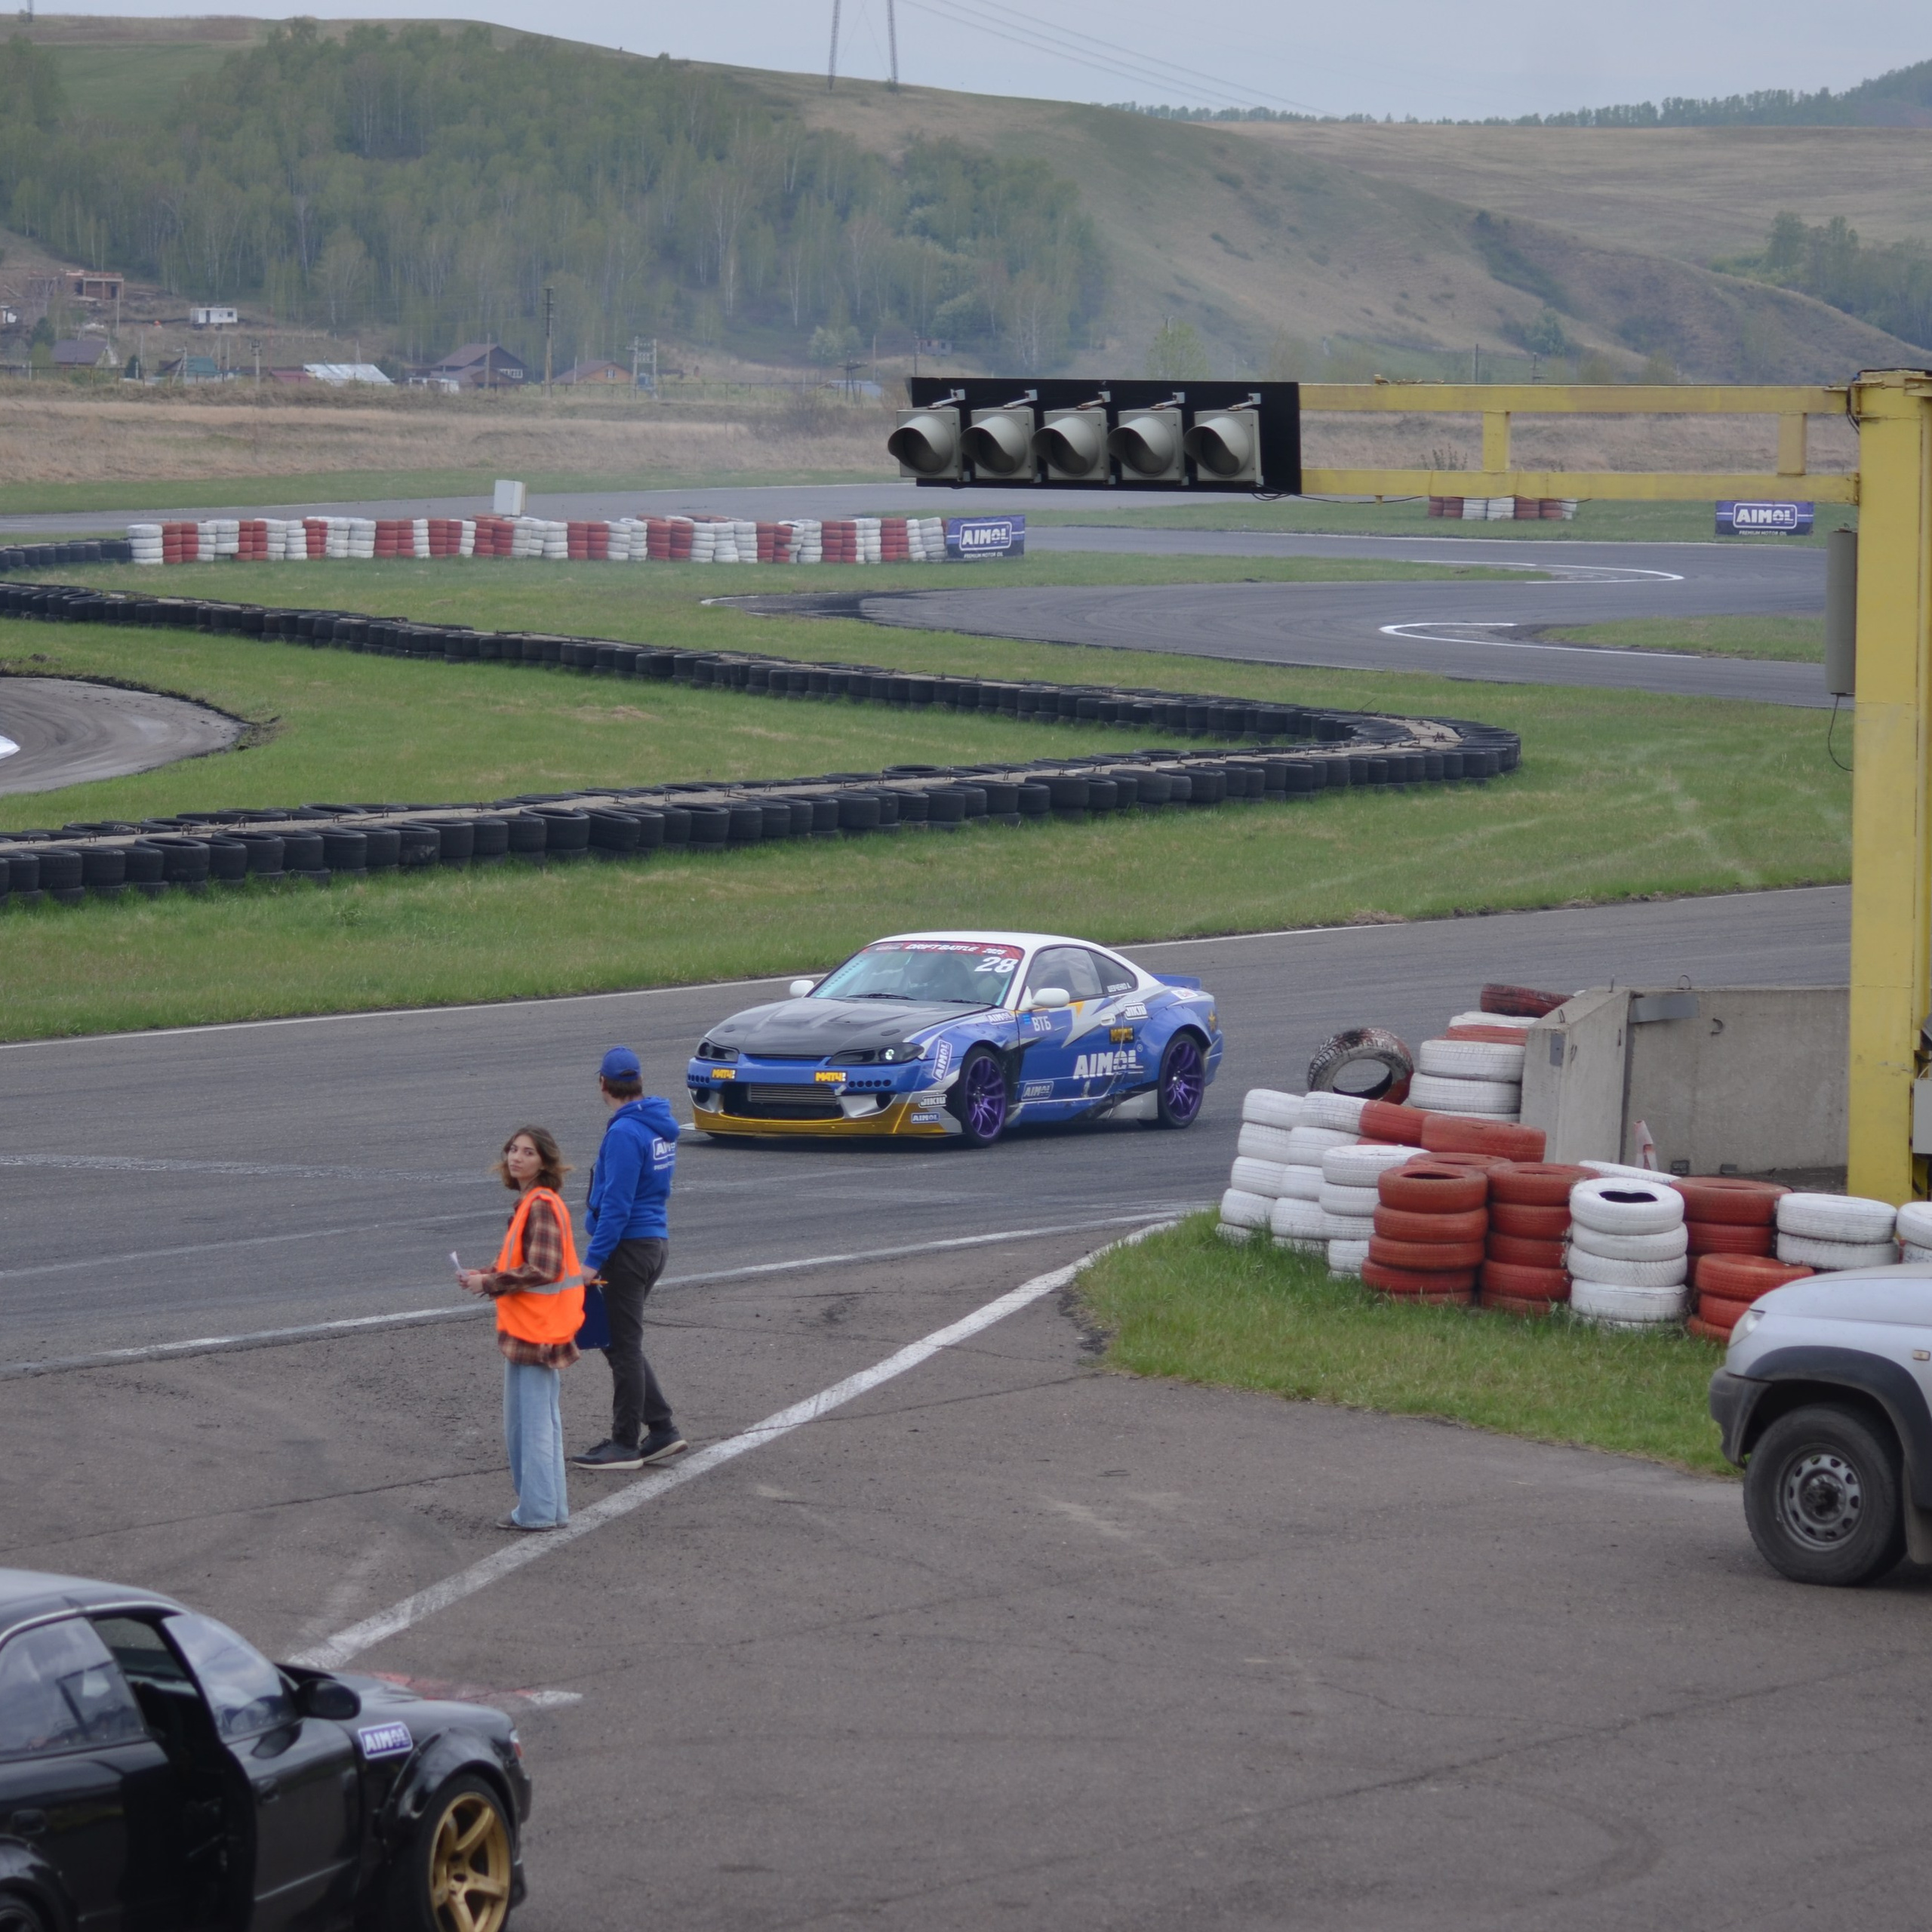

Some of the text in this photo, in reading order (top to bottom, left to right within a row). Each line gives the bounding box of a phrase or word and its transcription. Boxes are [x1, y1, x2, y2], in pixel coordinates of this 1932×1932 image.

[1737, 509, 1794, 524] AIMOL
[962, 528, 1009, 545] AIMOL
[974, 956, 1019, 973] 28
[986, 1013, 1013, 1023] AIMOL
[1031, 1016, 1052, 1032] ВТБ
[935, 1043, 949, 1080] AIMOL
[1073, 1050, 1144, 1080] AIMOL
[1024, 1084, 1051, 1097] AIMOL
[365, 1728, 409, 1752] AIMOL
